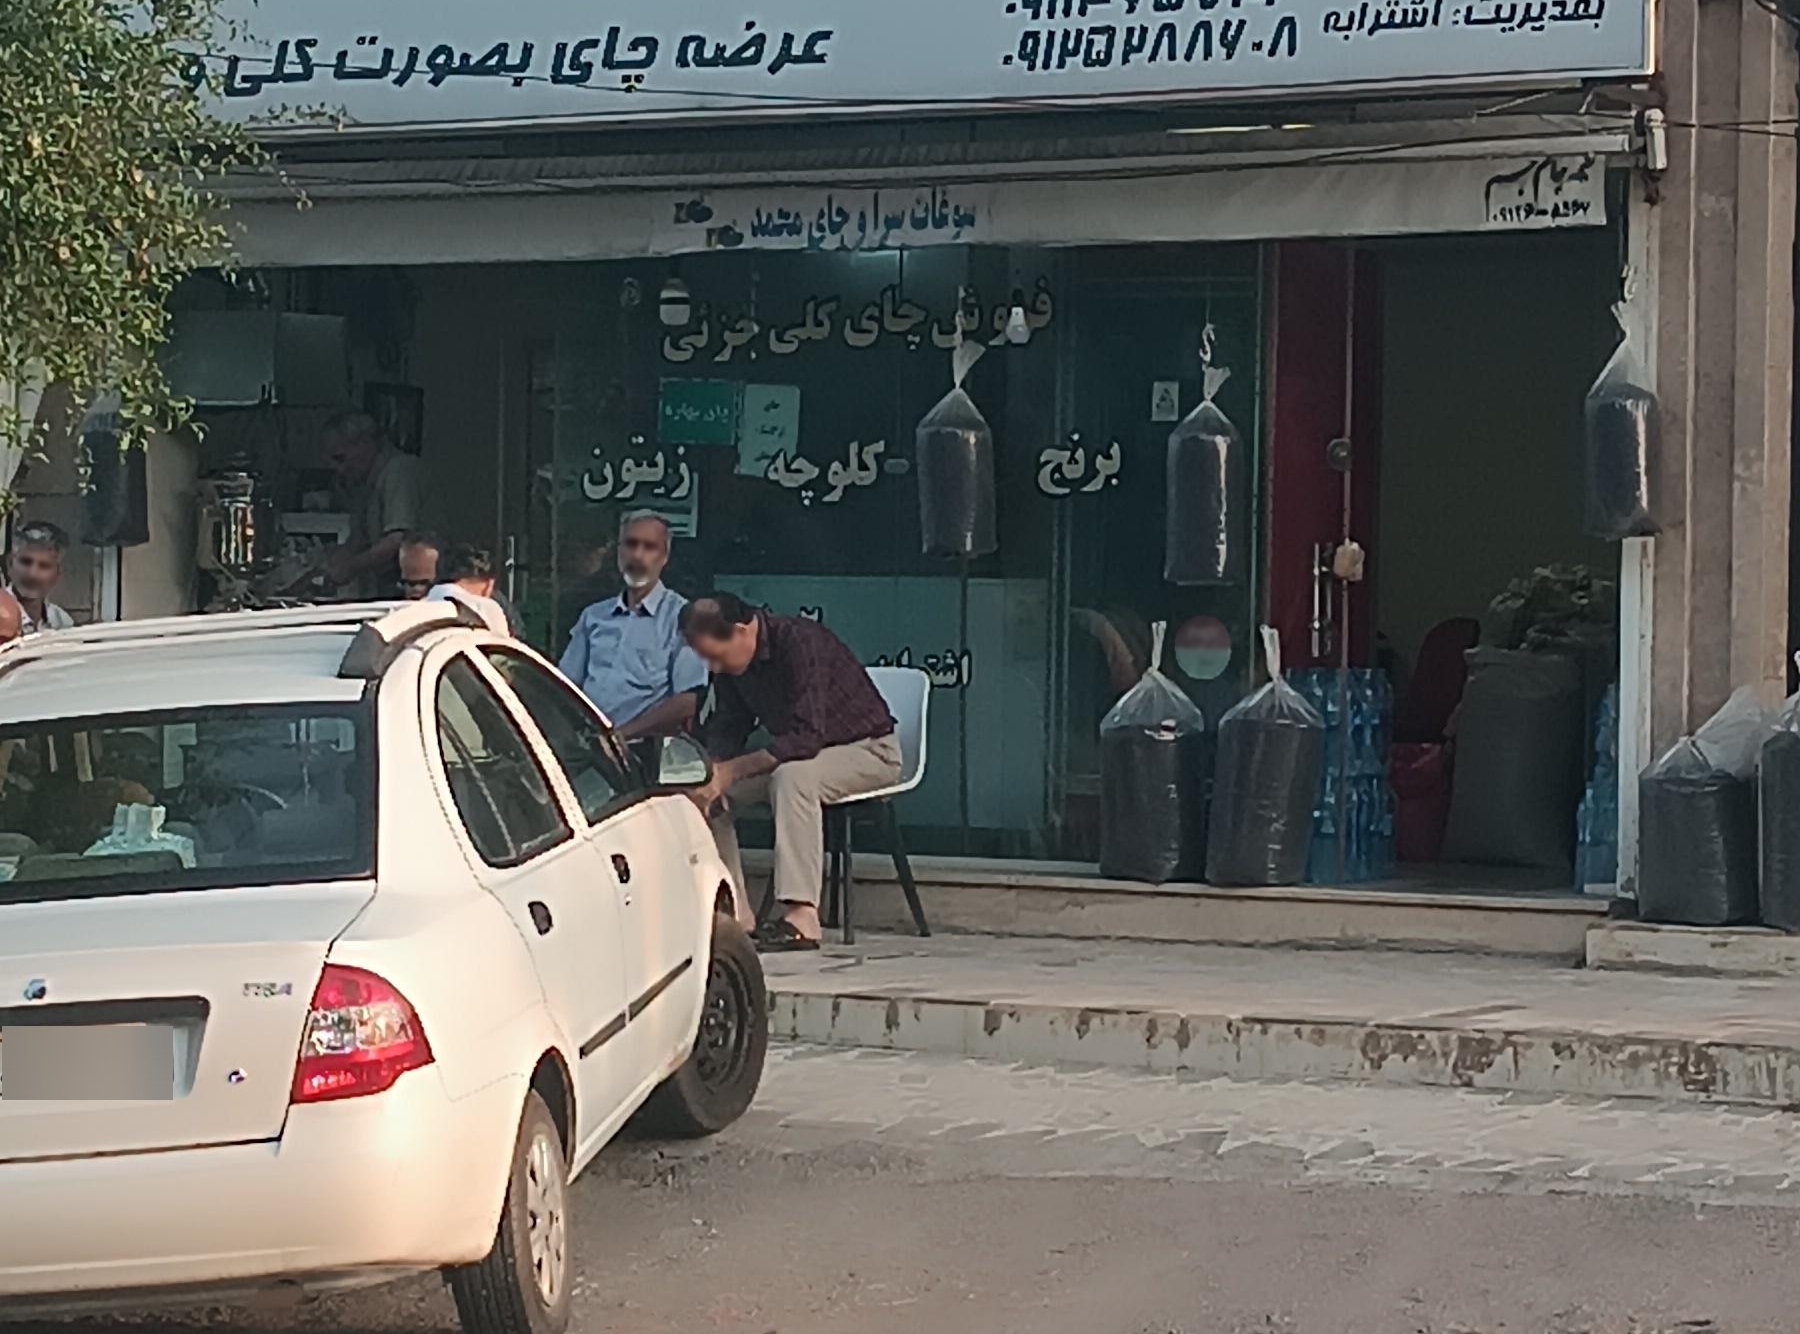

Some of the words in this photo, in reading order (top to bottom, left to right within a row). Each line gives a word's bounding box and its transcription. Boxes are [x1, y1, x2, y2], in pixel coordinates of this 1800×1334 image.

[223, 37, 319, 98] کلی
[333, 35, 535, 88] بصورت
[550, 25, 660, 94] چای
[675, 20, 834, 75] عرضه
[750, 206, 803, 238] محمد
[909, 185, 977, 241] سوغات
[768, 294, 840, 355] کلی
[842, 284, 927, 351] چای
[582, 435, 692, 500] زیتون
[766, 439, 886, 507] کلوچه
[1037, 432, 1122, 497] برنج
